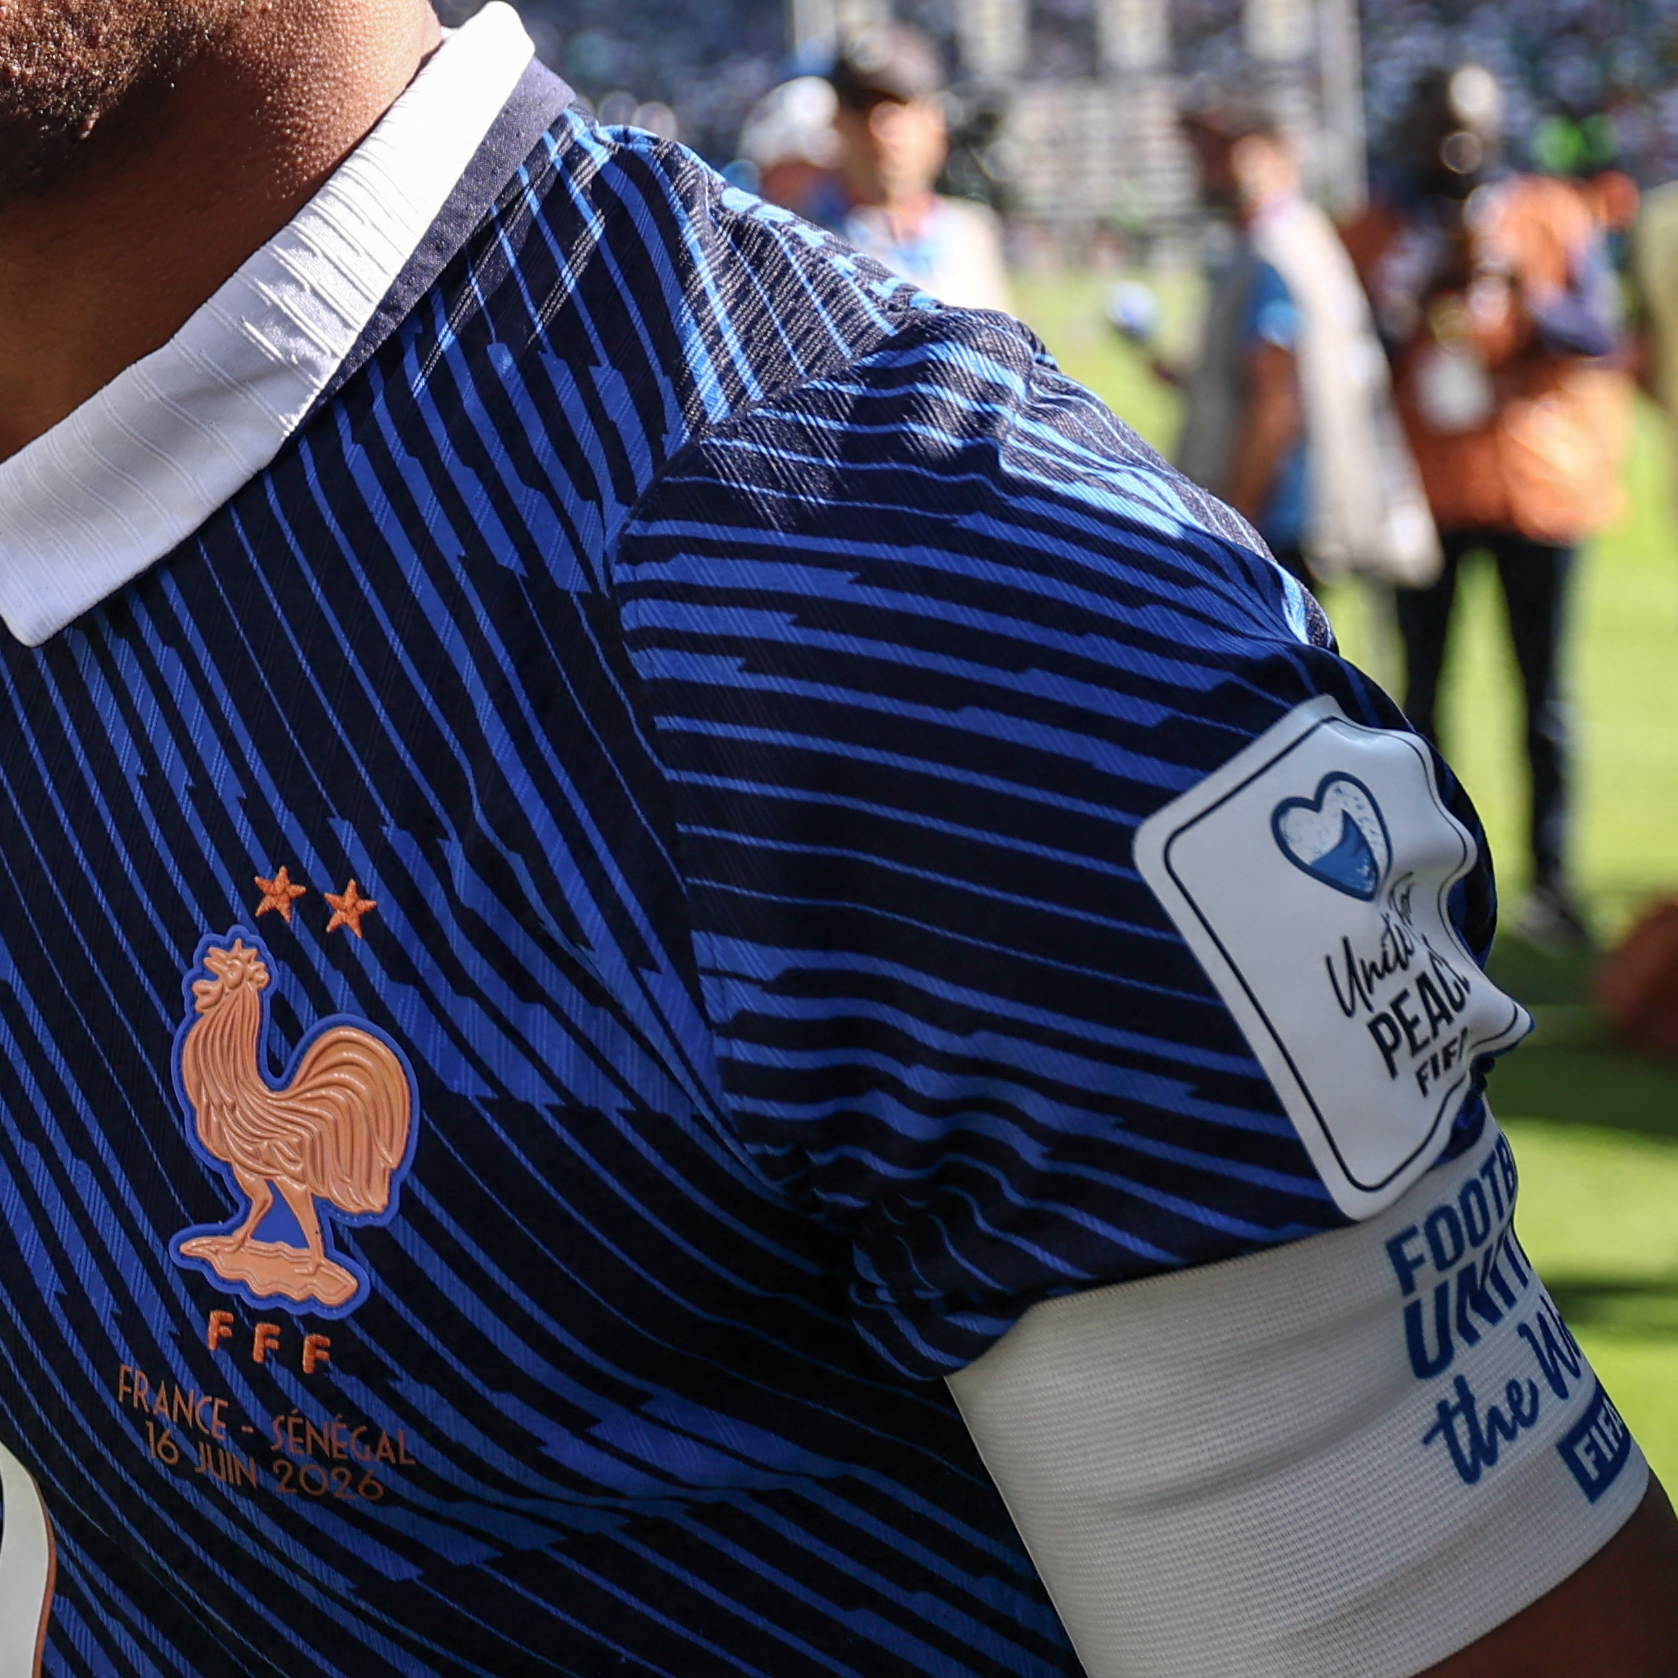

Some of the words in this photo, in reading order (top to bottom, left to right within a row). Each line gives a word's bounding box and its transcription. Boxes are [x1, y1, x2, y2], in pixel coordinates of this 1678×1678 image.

[1367, 934, 1470, 1080] PEAC
[1403, 1225, 1532, 1379] UNIT
[118, 1363, 229, 1440] FRANCE
[271, 1408, 416, 1465] SÉNÉGAL
[145, 1421, 180, 1465] 16
[195, 1441, 258, 1489] JUIN
[272, 1459, 384, 1500] 2026
[1422, 1374, 1539, 1485] the
